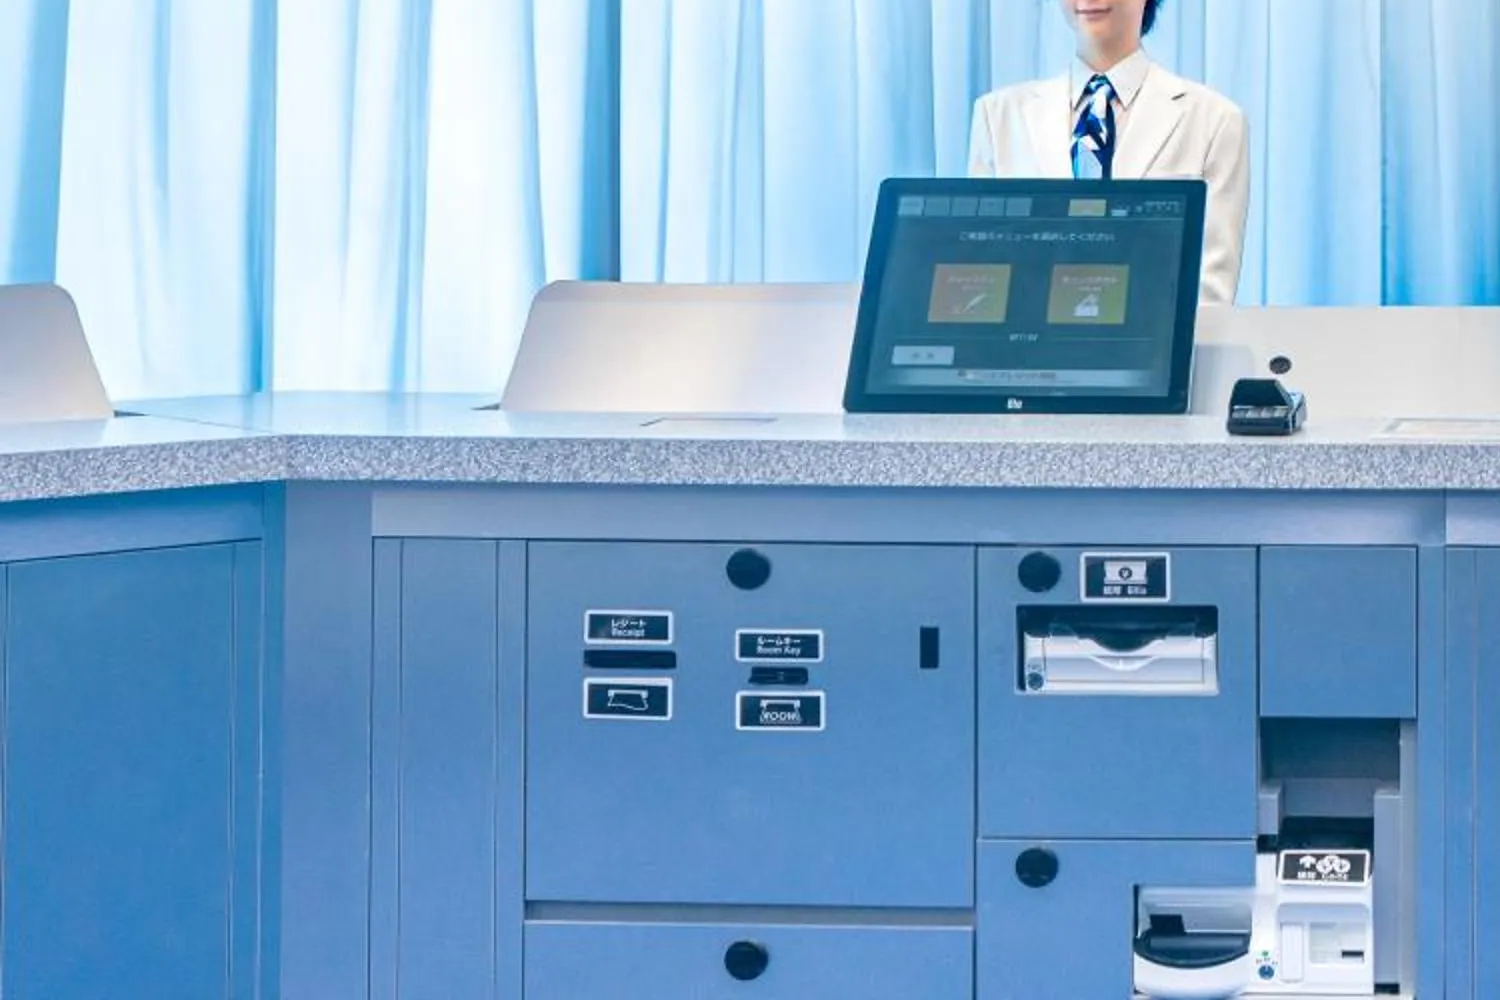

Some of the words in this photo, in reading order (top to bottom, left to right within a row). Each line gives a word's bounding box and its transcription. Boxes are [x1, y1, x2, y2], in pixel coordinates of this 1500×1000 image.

[611, 629, 645, 637] Receipt
[757, 646, 782, 655] Room
[784, 647, 801, 658] Key
